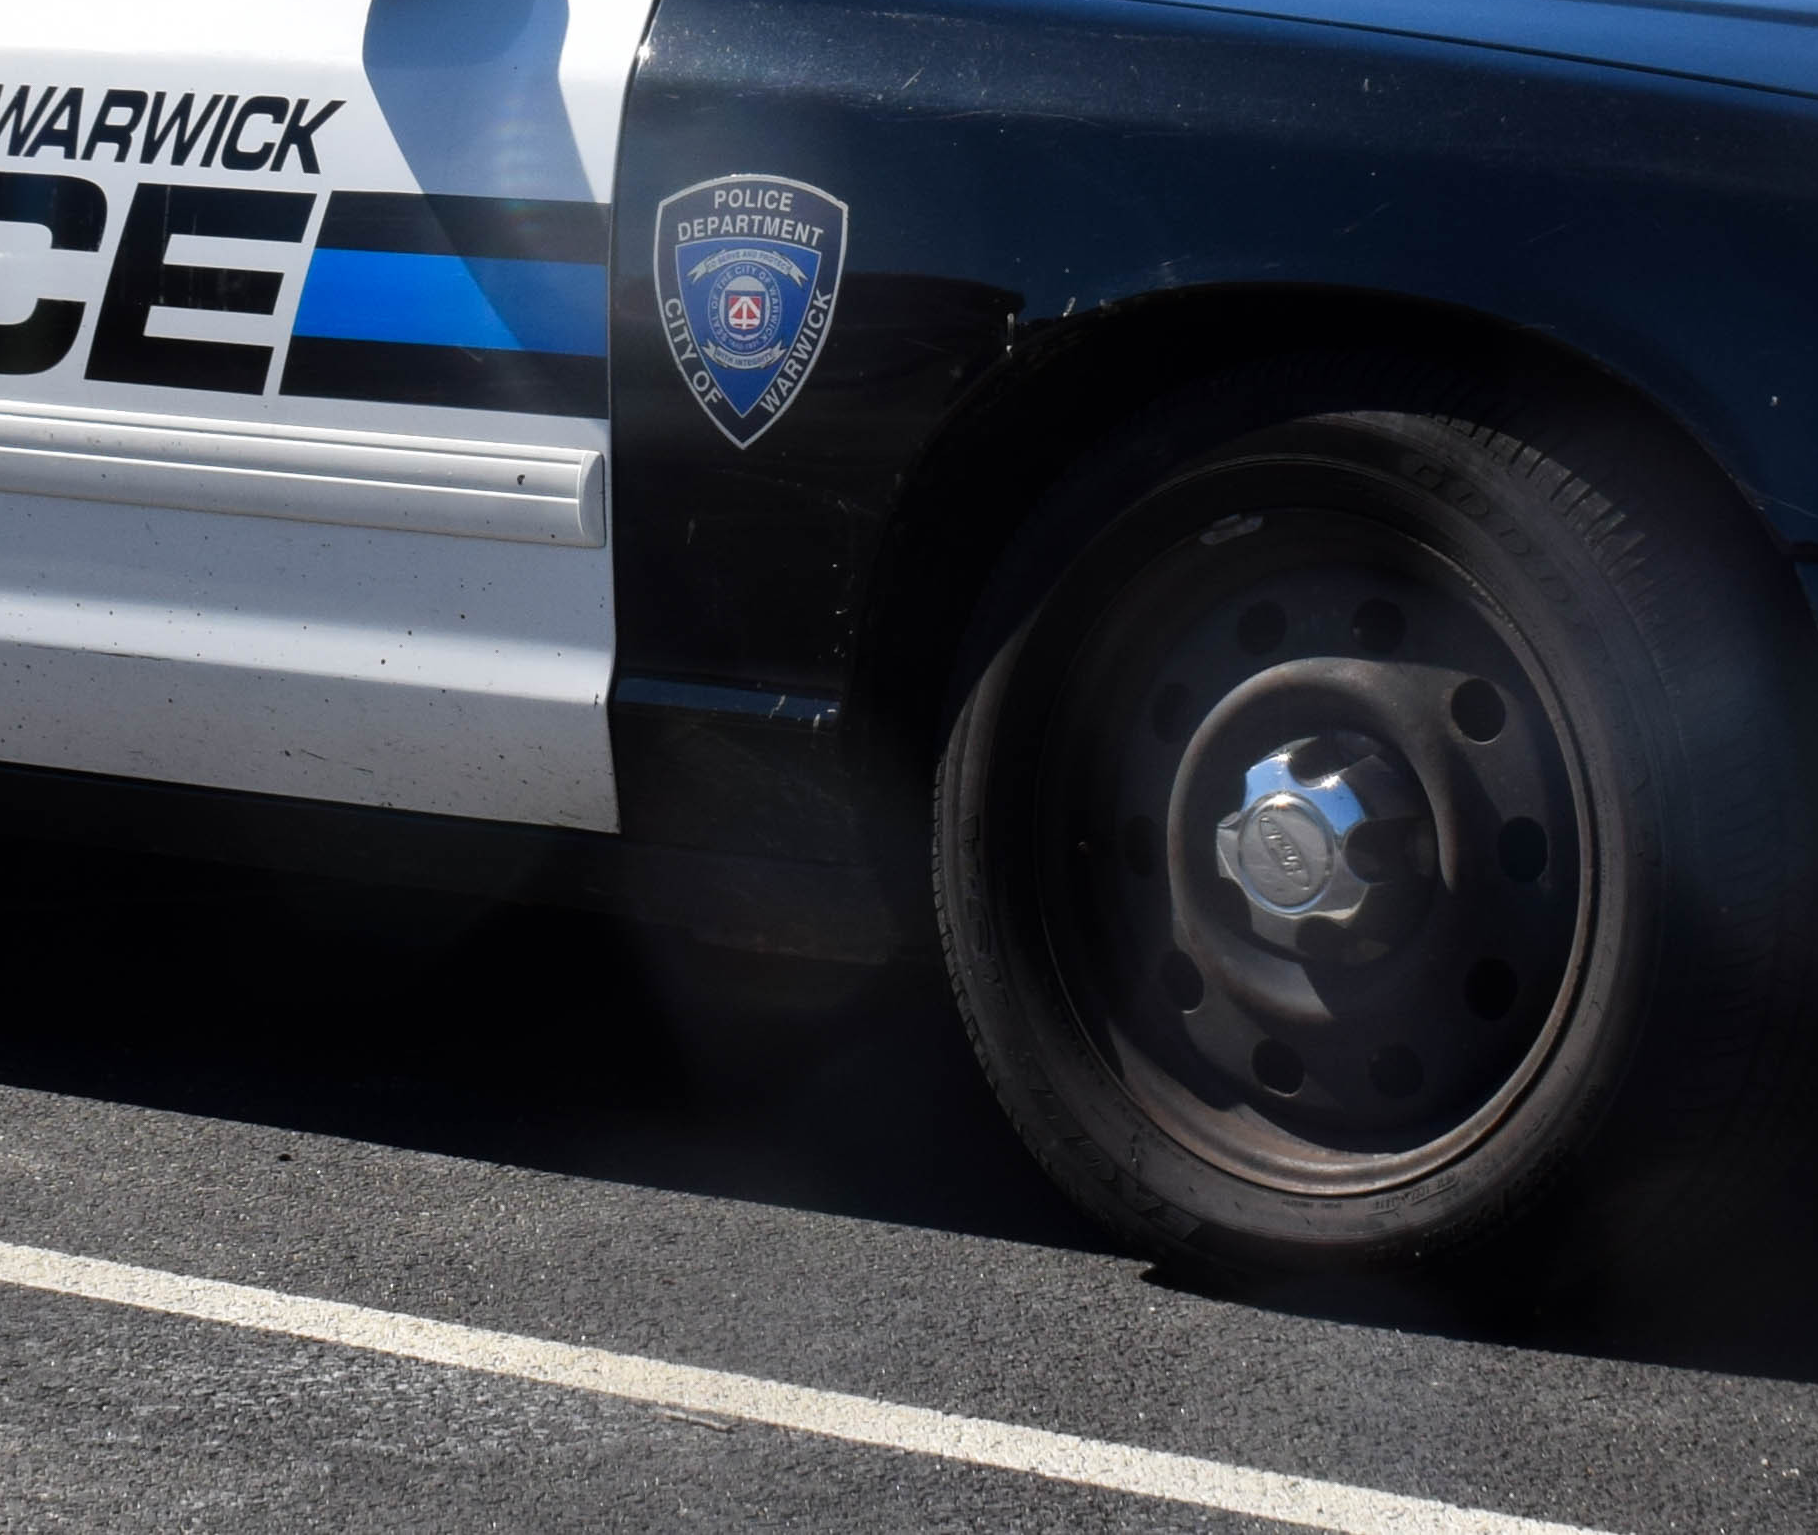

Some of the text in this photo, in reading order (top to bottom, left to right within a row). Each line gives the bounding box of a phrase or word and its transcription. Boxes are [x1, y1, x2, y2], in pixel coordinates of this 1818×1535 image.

[714, 188, 794, 213] POLICE
[678, 214, 824, 247] DEPARTMENT
[734, 265, 758, 275] CITY
[664, 289, 833, 415] CITY OF WARWICK
